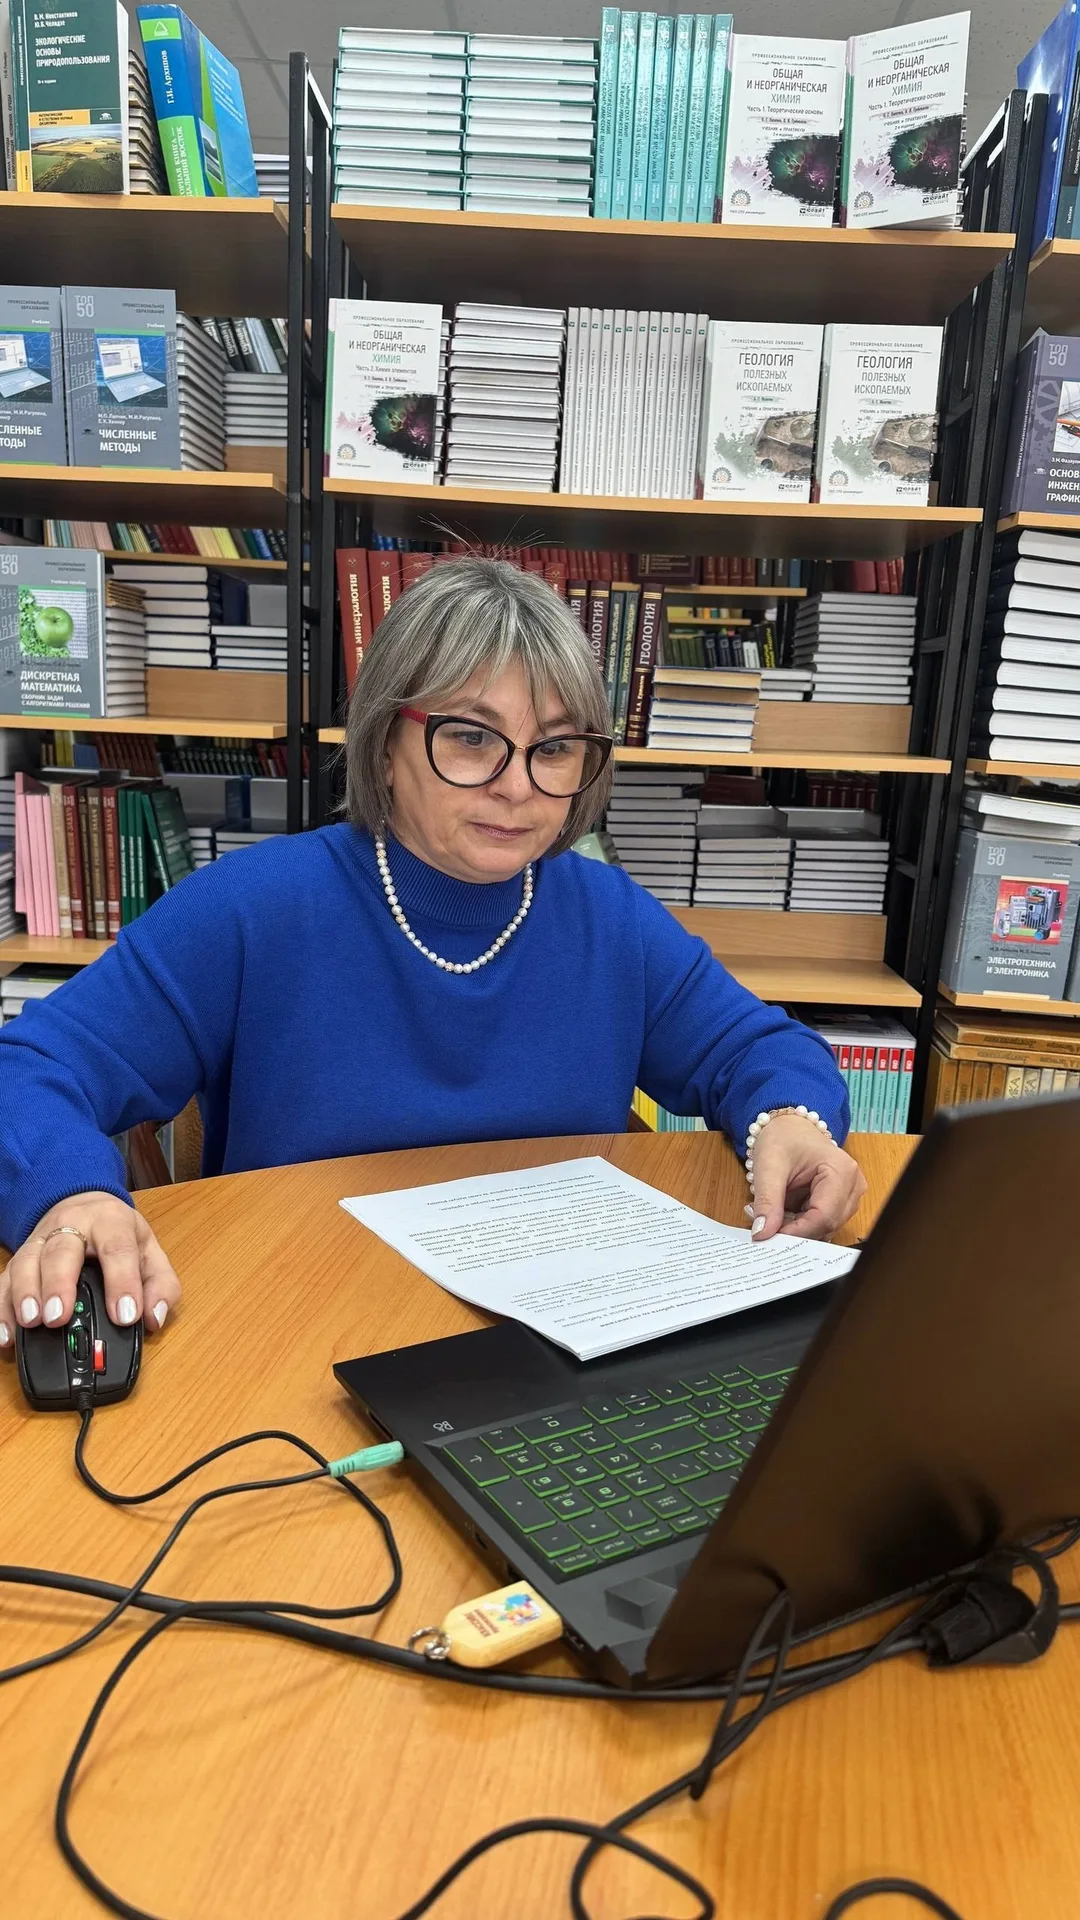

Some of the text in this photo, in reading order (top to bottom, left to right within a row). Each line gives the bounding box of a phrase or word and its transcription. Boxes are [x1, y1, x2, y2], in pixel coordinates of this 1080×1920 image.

[35, 35, 86, 46] ЭКОЛОГИЧЕСКИЕ
[35, 47, 62, 57] ОСНОВЫ
[36, 55, 111, 68] ПРИРОДОПОЛЬЗОВАНИЯ
[893, 54, 925, 71] ОБЩАЯ
[161, 50, 175, 105] Г.И. Архипов
[772, 67, 804, 80] ОБЩАЯ
[867, 62, 950, 89] И НЕОРГАНИЧЕСКАЯ
[746, 80, 828, 93] И НЕОРГАНИЧЕСКАЯ
[891, 80, 923, 97] ХИМИЯ
[770, 93, 801, 104] ХИМИЯ
[868, 103, 883, 111] Часть
[888, 95, 927, 108] Теоретические
[926, 91, 946, 100] основы
[767, 106, 805, 115] Теоретические
[175, 126, 188, 157] ВОСТОК
[172, 138, 181, 166] КНИГА
[74, 294, 94, 305] ТОП
[76, 303, 95, 318] 50
[373, 329, 403, 341] ОБЩАЯ
[348, 341, 427, 354] И НЕОРГАНИЧЕСКАЯ
[1048, 343, 1069, 353] ТОП
[371, 353, 402, 364] ХИМИЯ
[738, 352, 794, 367] ГЕОЛОГИЯ
[856, 355, 913, 370] ГЕОЛОГИЯ
[1048, 352, 1068, 367] 50
[743, 369, 788, 380] ПОЛЕЗНЫХ
[861, 371, 907, 383] ПОЛЕЗНЫХ
[736, 381, 793, 393] ИСКОПАЕМЫХ
[854, 384, 912, 395] ИСКОПАЕМЫХ
[98, 428, 157, 441] ЧИСЛЕННЫЕ
[99, 442, 141, 454] МЕТОДЫ
[1, 561, 19, 575] 50
[349, 573, 363, 645] минералогия
[639, 602, 656, 665] ГЕОЛОГИЯ
[20, 670, 80, 682] ДИСКРЕТНАЯ
[20, 681, 83, 693] МАТЕМАТИКА
[21, 693, 46, 701] СБОРНИК
[26, 700, 65, 708] АЛГОРИТМАМИ
[987, 846, 1007, 855] ТОП
[987, 853, 1005, 866] 50
[987, 956, 1057, 969] ЭЛЕКТРОТЕХНИКА
[986, 966, 1050, 979] И ЭЛЕКТРОНИКА
